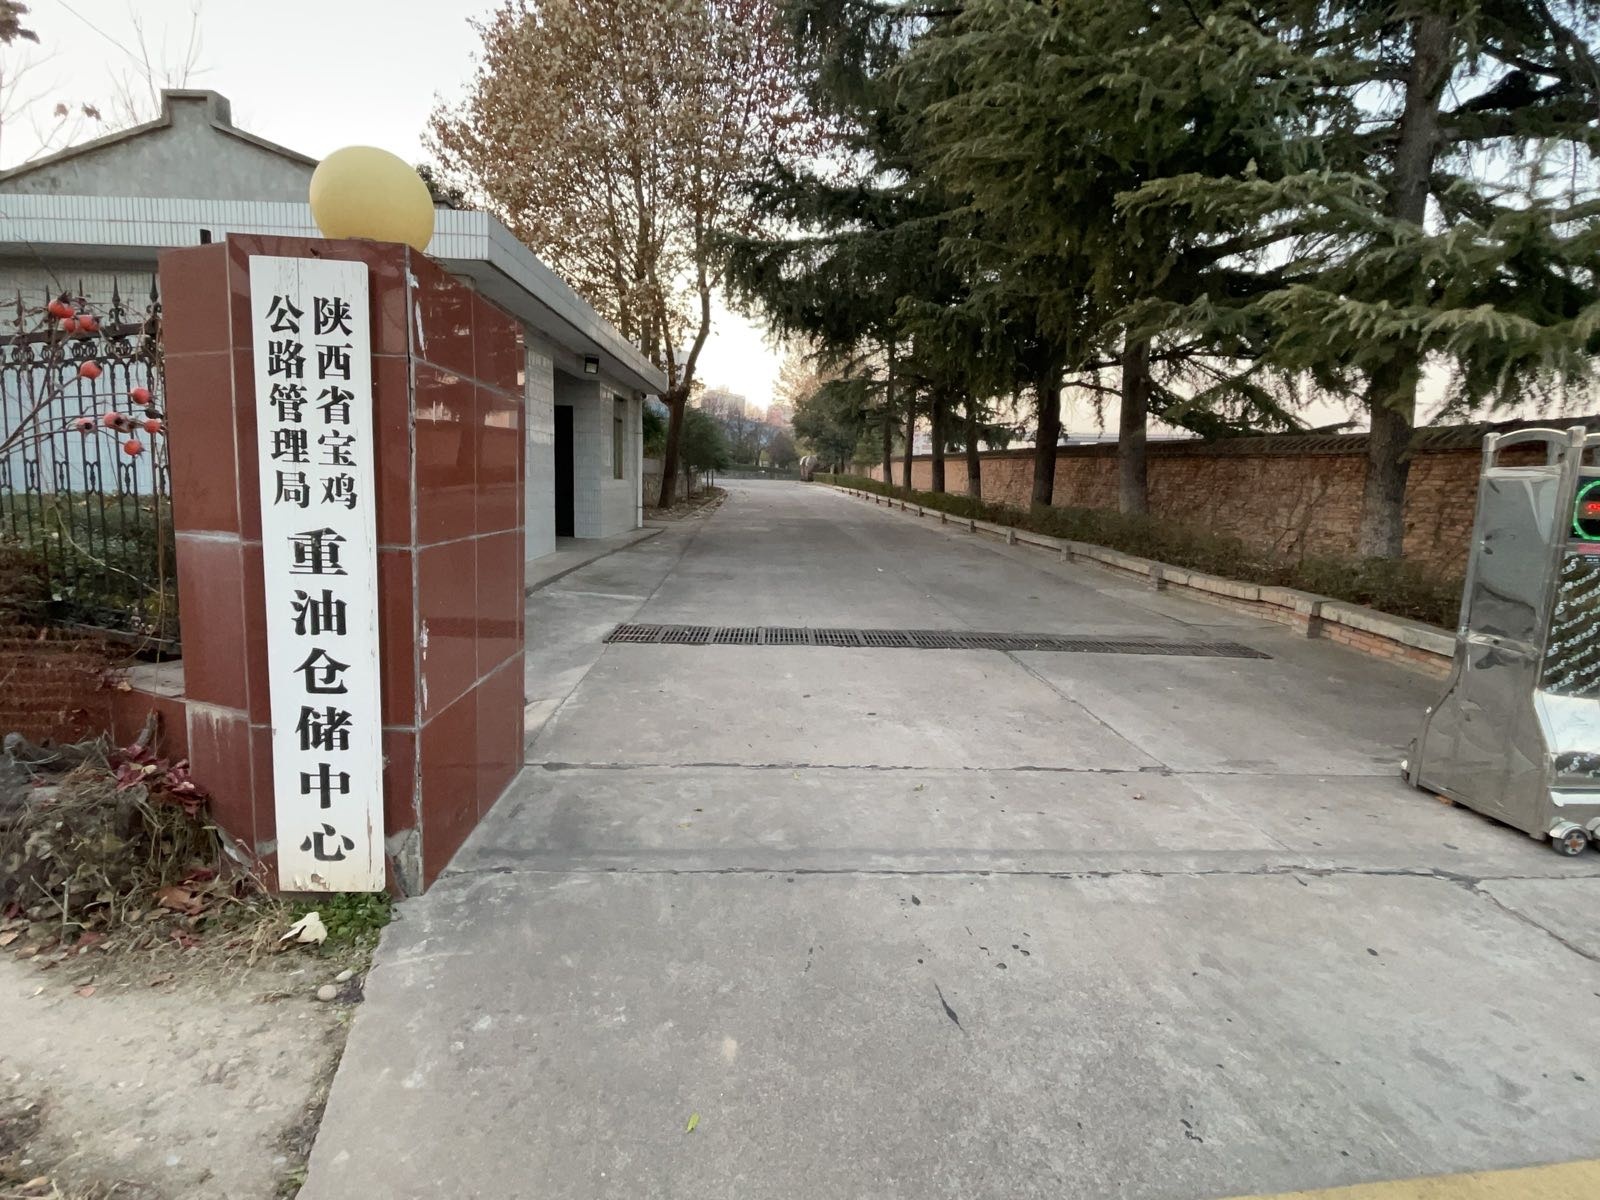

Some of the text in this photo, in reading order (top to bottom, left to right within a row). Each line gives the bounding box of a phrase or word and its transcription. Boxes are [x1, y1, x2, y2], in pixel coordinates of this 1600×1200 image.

[265, 294, 311, 509] 公路管理局
[313, 296, 358, 510] 陕西省宝鸡
[287, 527, 355, 862] 重油仓储中心
